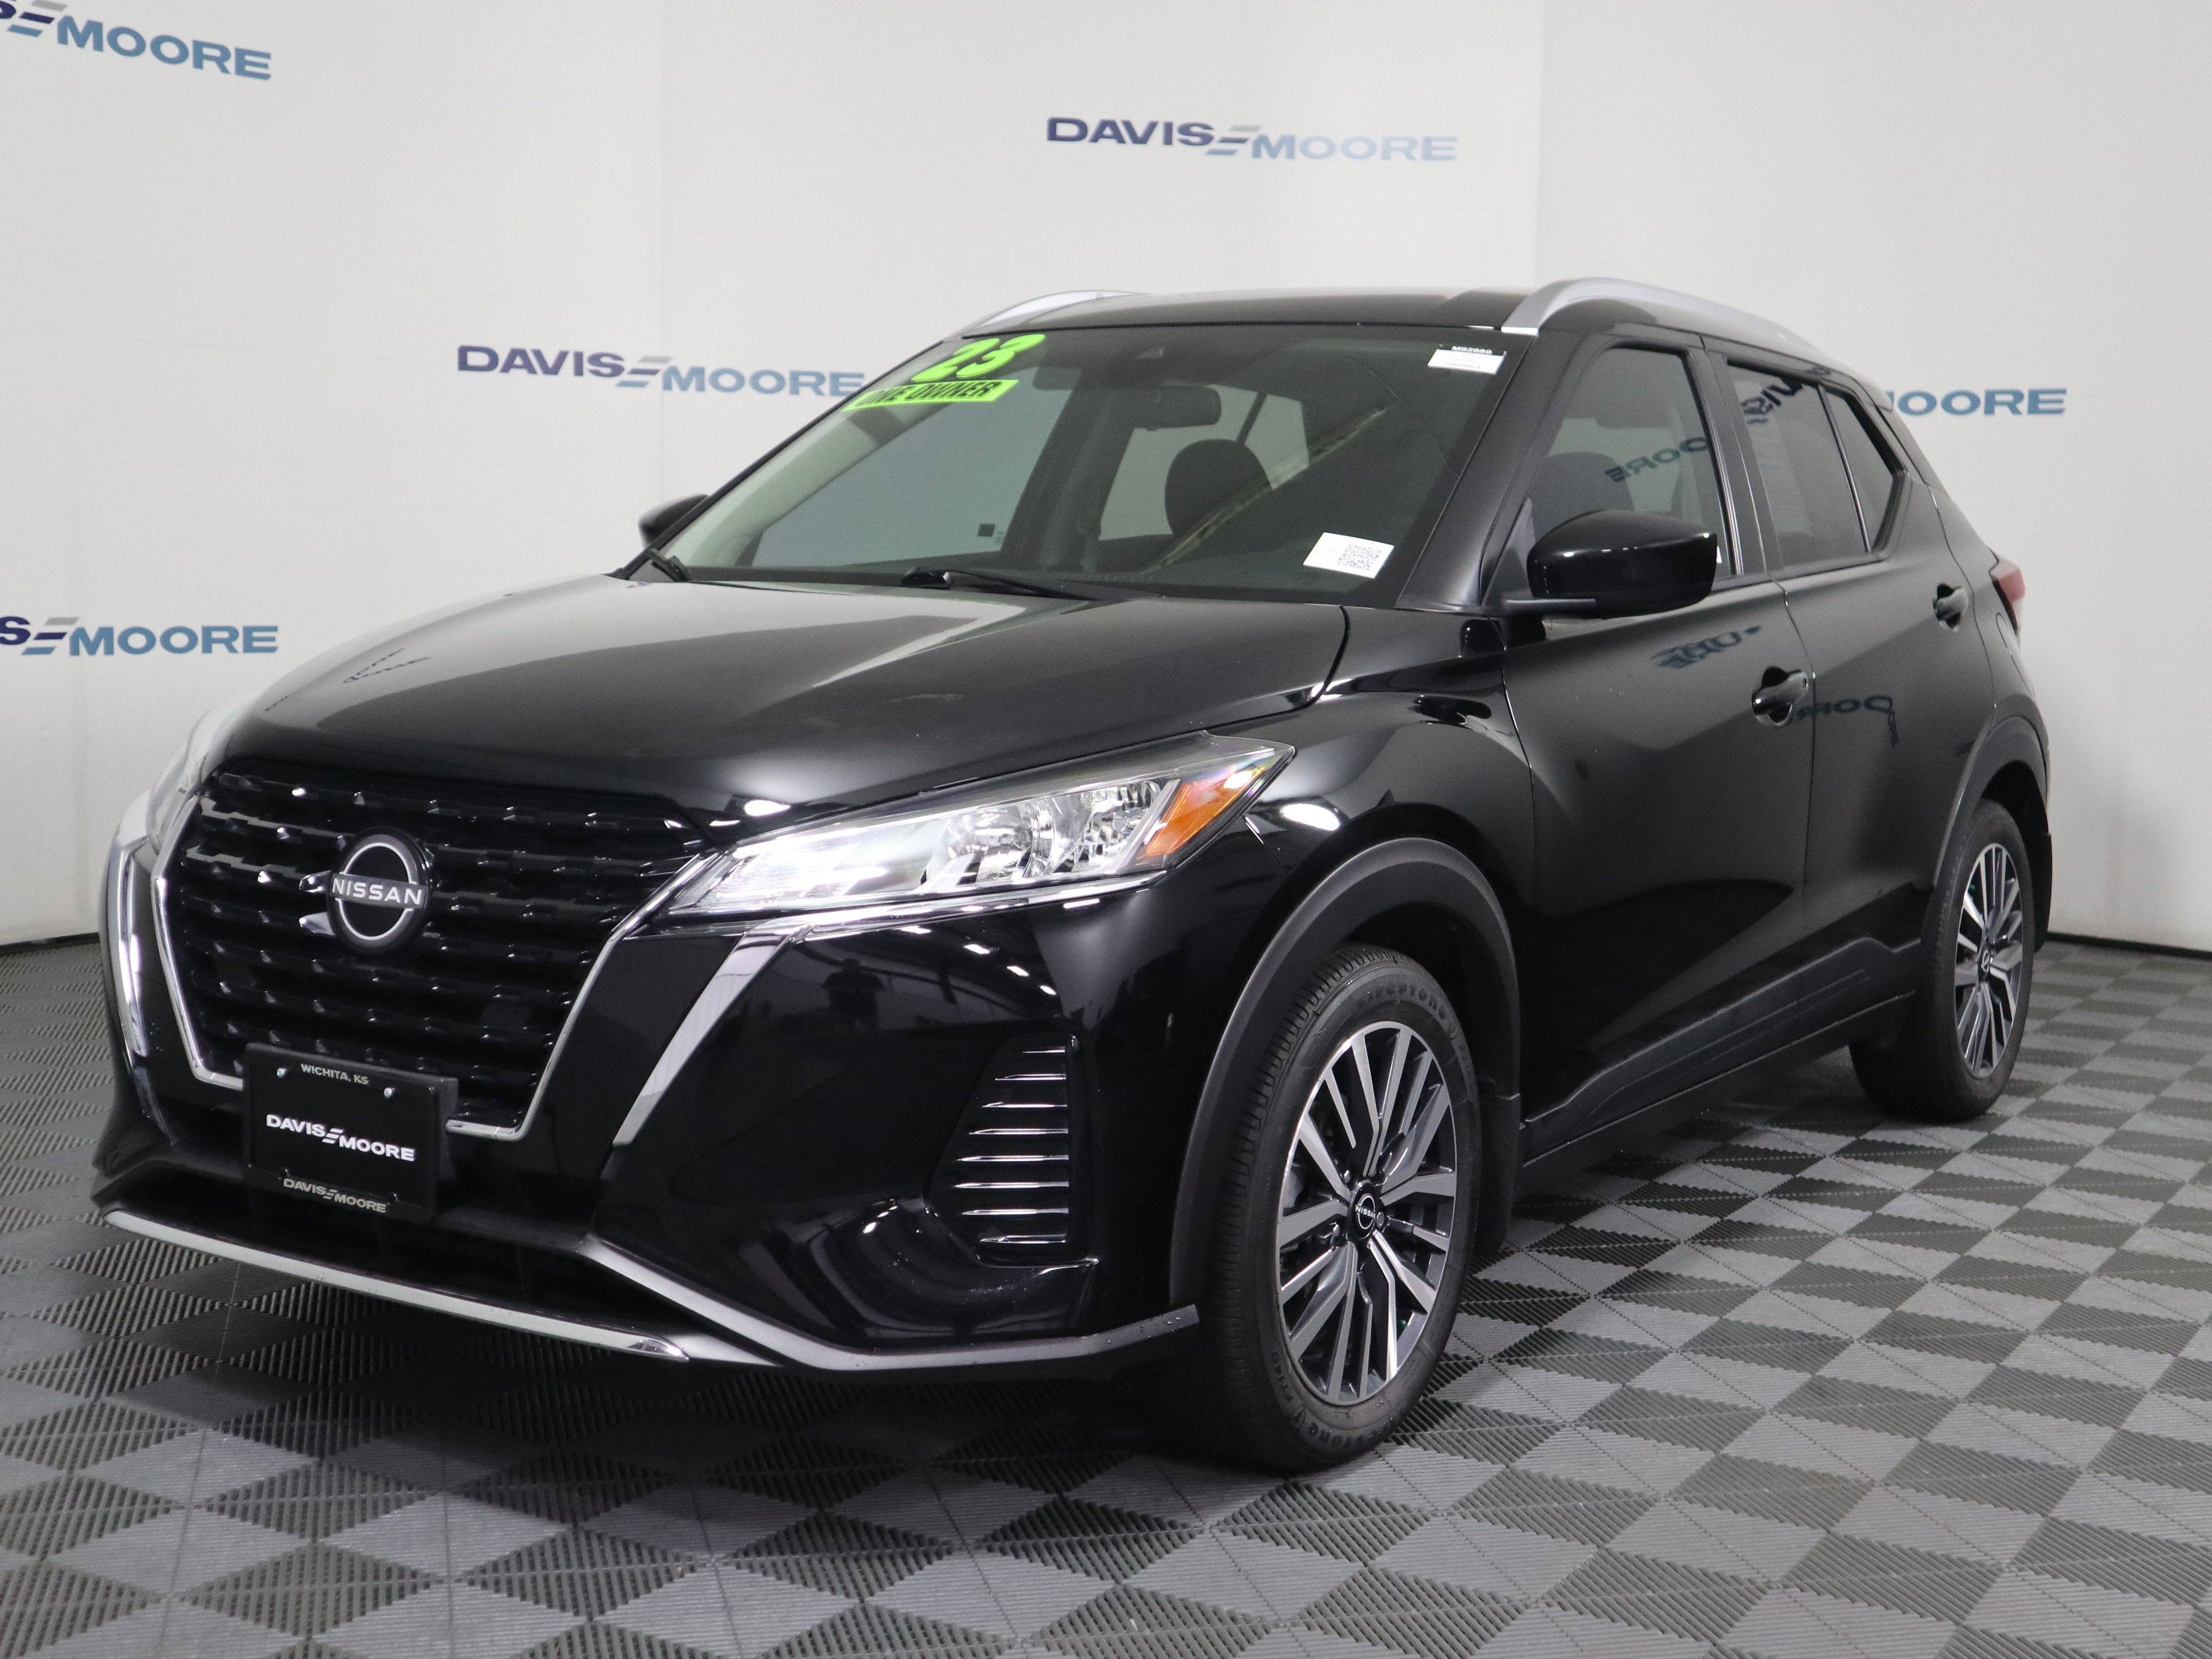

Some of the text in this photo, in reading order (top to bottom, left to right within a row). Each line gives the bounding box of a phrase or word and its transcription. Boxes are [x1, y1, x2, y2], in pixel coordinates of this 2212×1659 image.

[57, 15, 272, 81] MOORE
[1046, 117, 1458, 162] DAVIS MOORE
[457, 345, 865, 397] DAVIS MOORE
[910, 333, 1046, 382] 23
[904, 381, 1003, 401] OWNER
[1885, 387, 2067, 416] OORE
[69, 626, 279, 656] MOORE
[331, 878, 422, 905] NISSAN
[300, 1063, 370, 1086] WICHITA, KS
[266, 1113, 416, 1163] DAVIS MOORE
[282, 1177, 387, 1213] DAVIS MOORE
